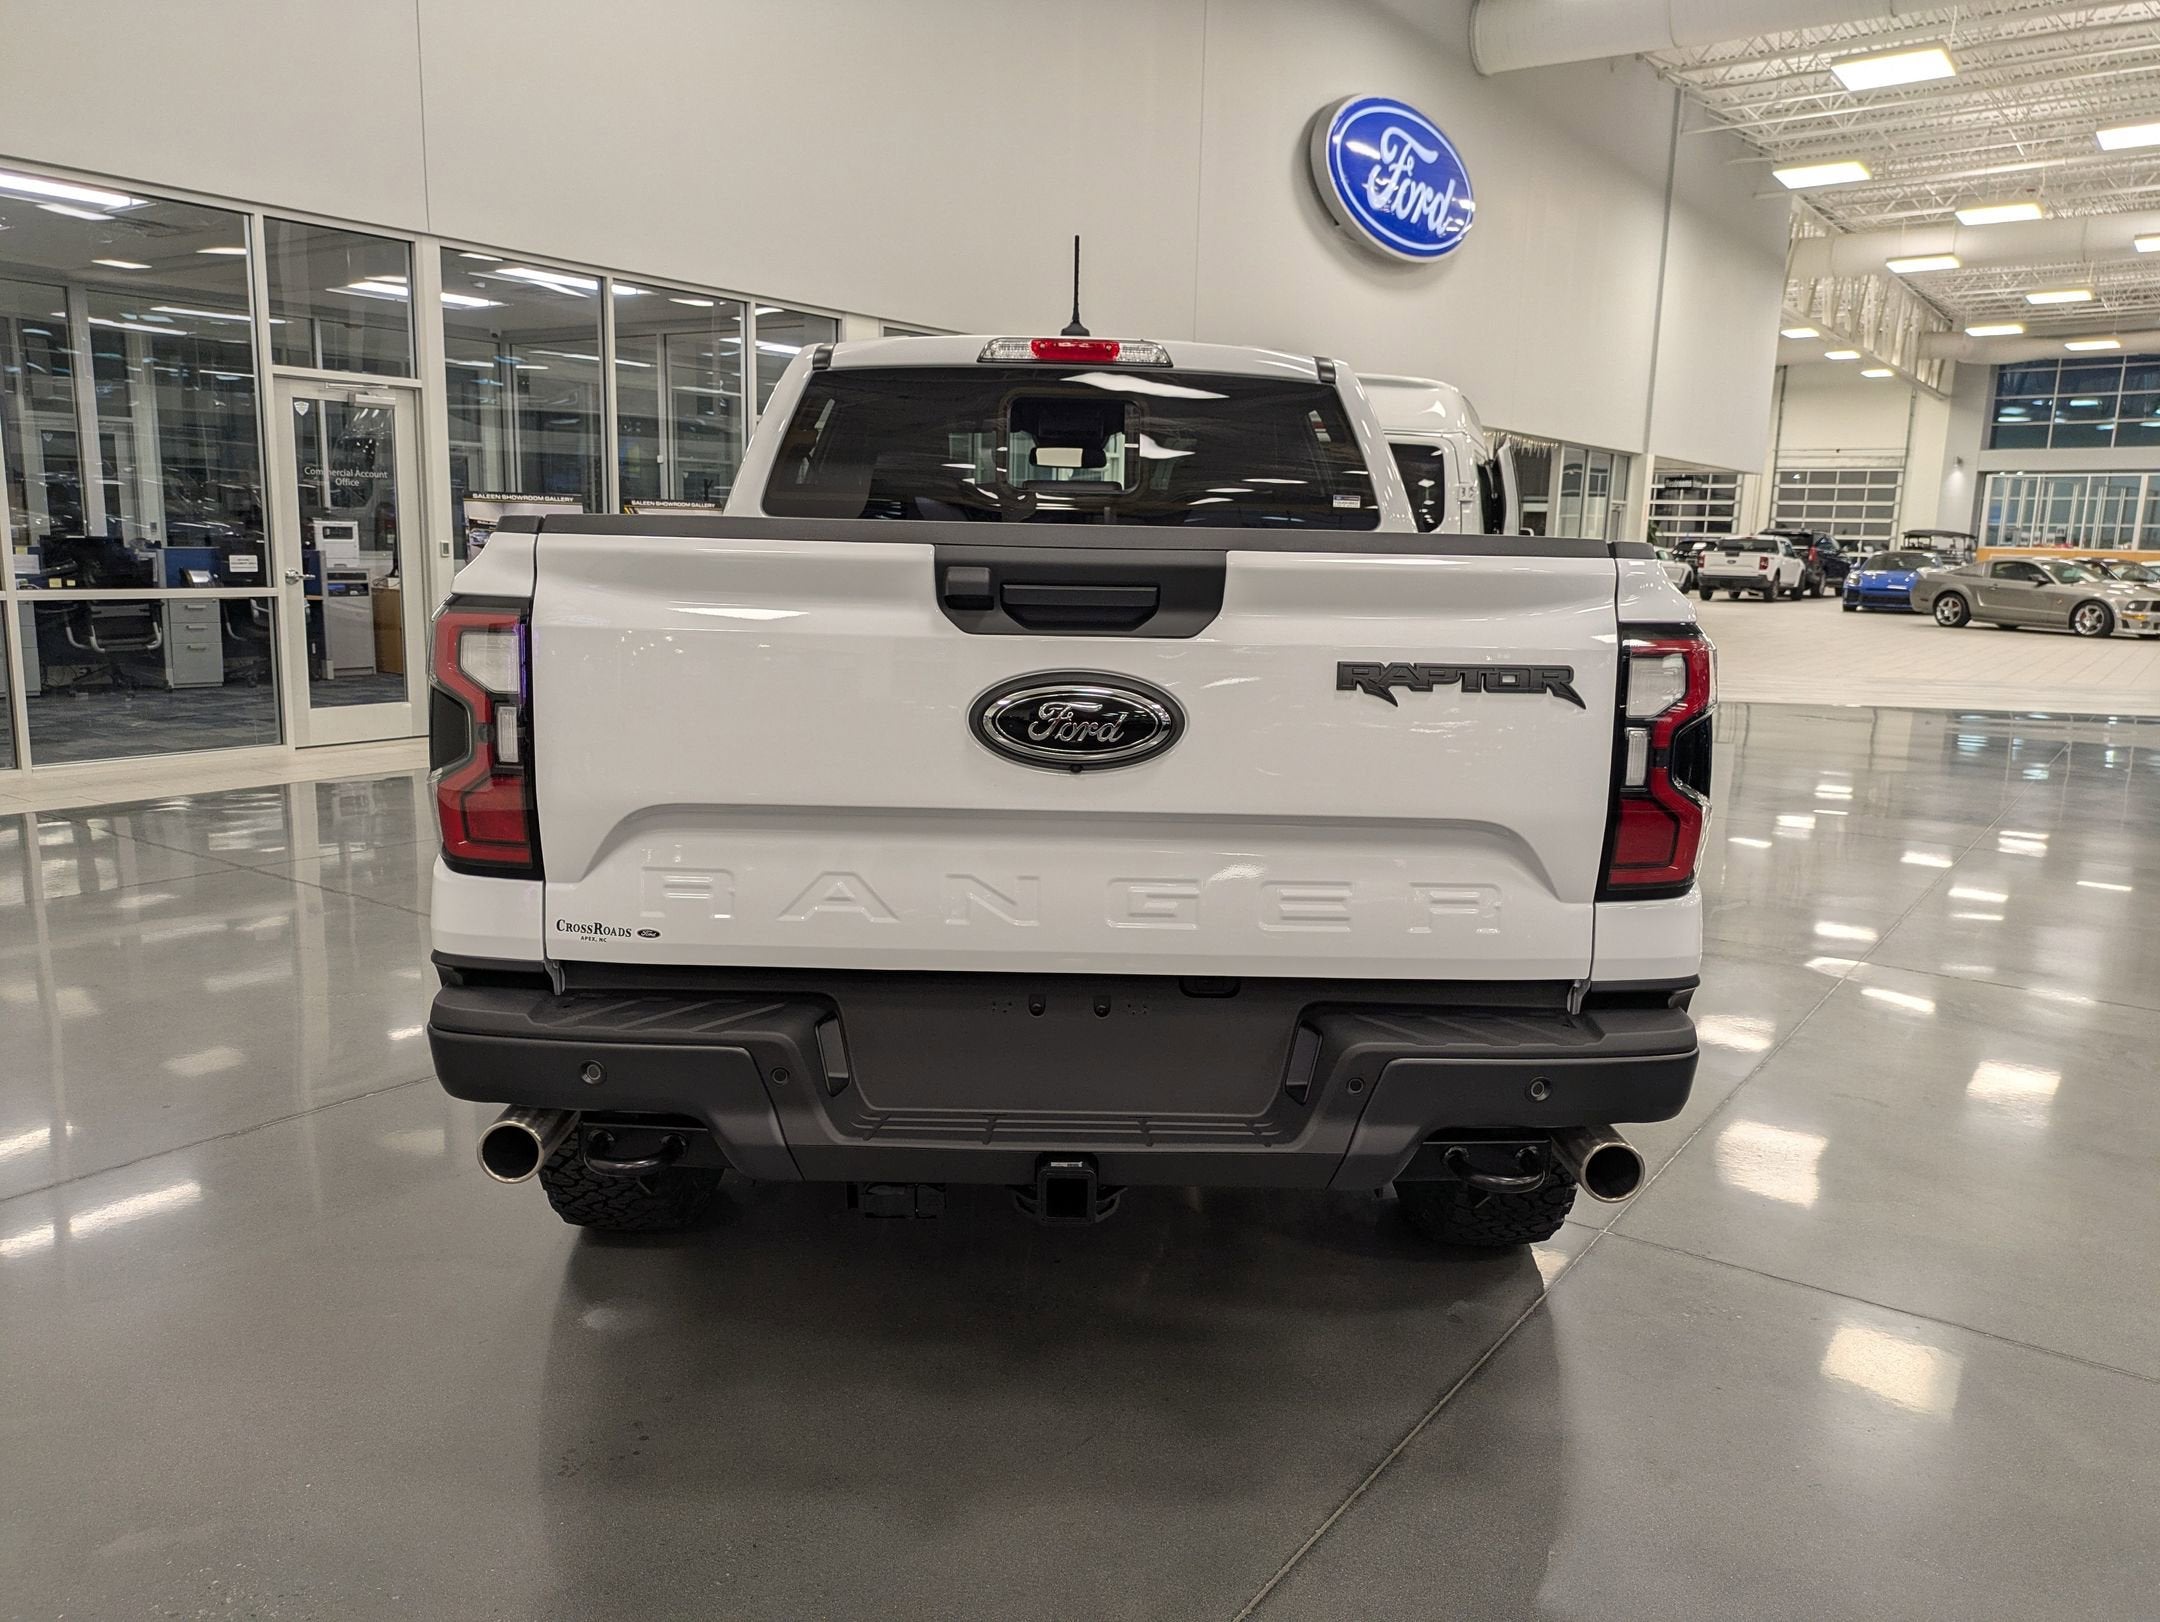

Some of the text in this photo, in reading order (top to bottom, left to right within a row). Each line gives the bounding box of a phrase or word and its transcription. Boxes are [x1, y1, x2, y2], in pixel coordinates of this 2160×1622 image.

[1366, 126, 1456, 235] Ford
[335, 477, 360, 487] Office
[354, 468, 388, 479] Account
[1336, 661, 1587, 710] RAPTOR
[1027, 701, 1129, 743] Ford
[641, 865, 1502, 935] RANGER
